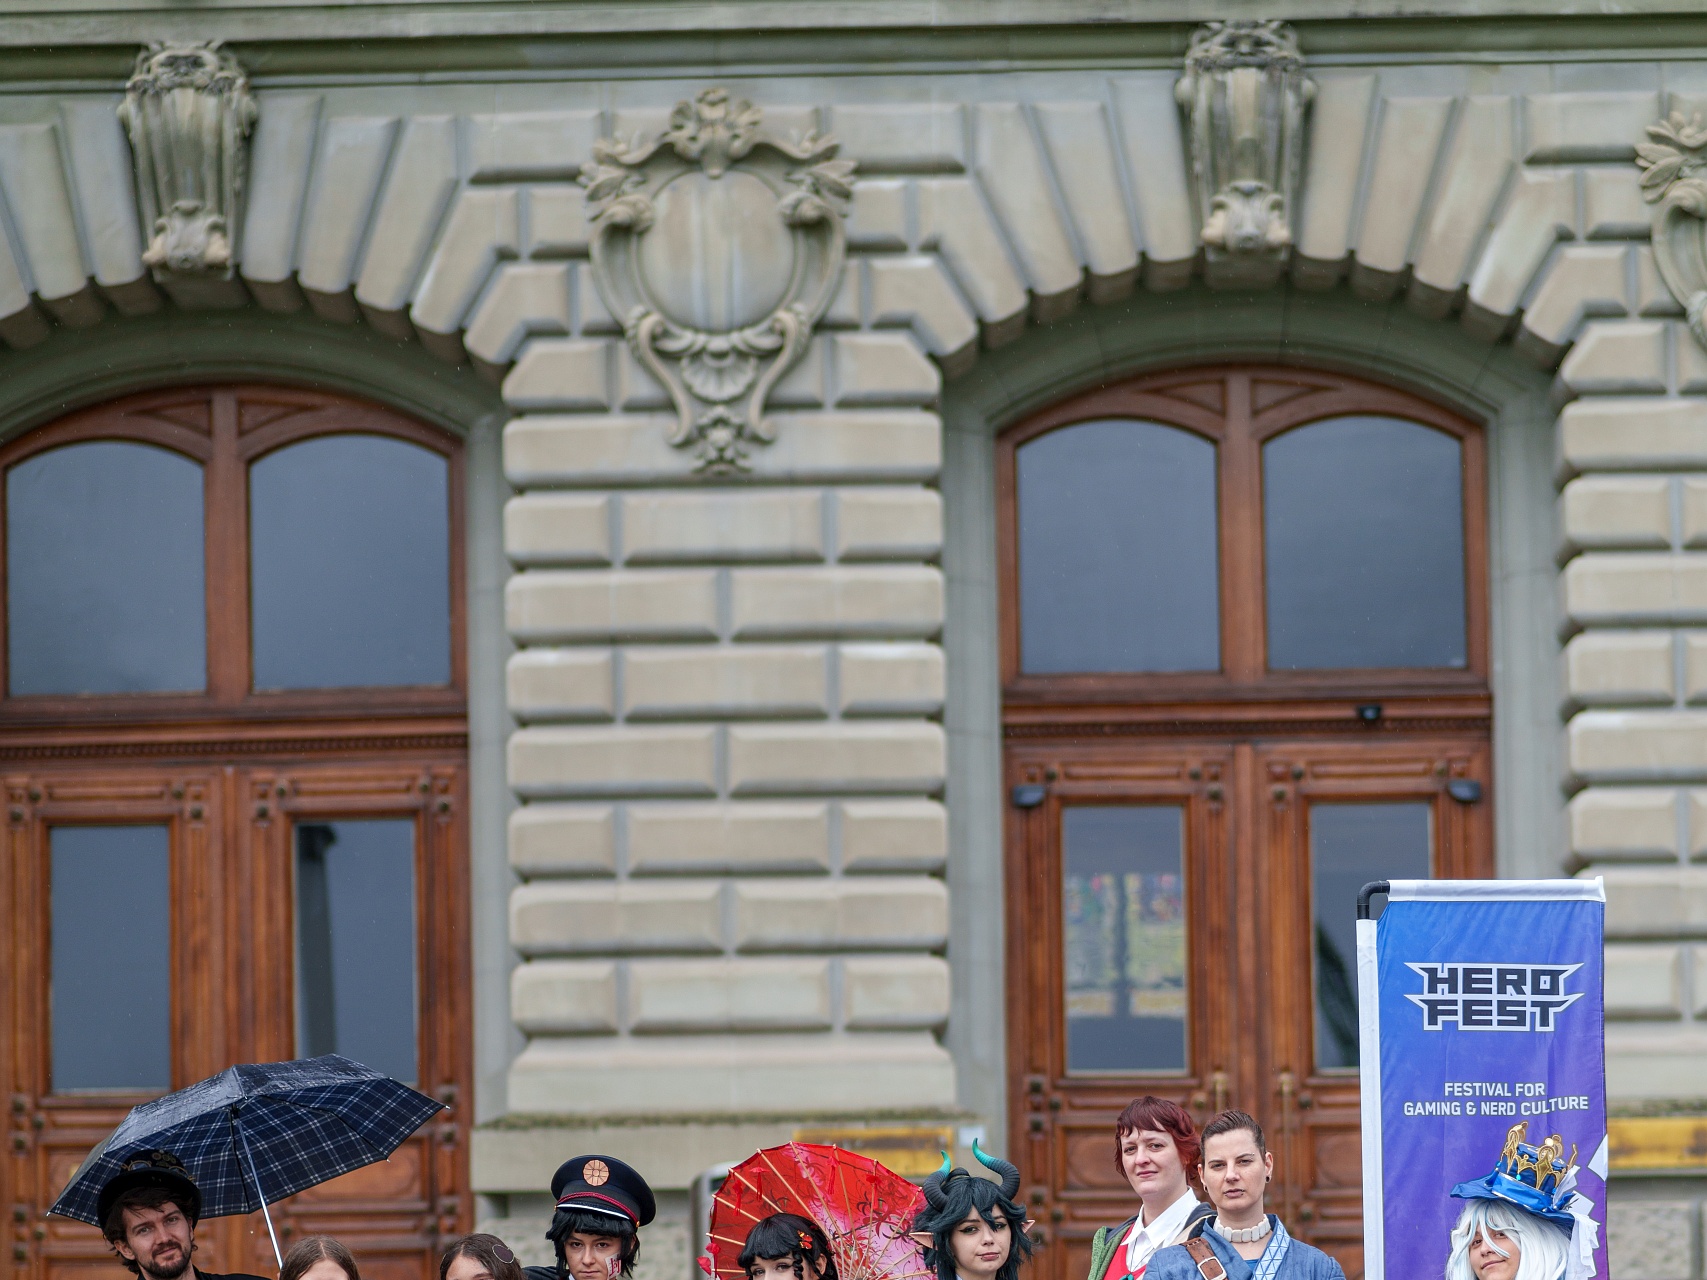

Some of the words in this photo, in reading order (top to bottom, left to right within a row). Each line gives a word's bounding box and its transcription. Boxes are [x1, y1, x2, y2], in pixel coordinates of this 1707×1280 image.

[1409, 963, 1578, 996] HERO
[1409, 996, 1578, 1031] FEST
[1444, 1082, 1512, 1097] FESTIVAL
[1515, 1082, 1546, 1097] FOR
[1403, 1101, 1462, 1116] GAMING
[1465, 1101, 1477, 1116] &
[1480, 1101, 1516, 1116] NERD
[1519, 1096, 1589, 1116] CULTURE
